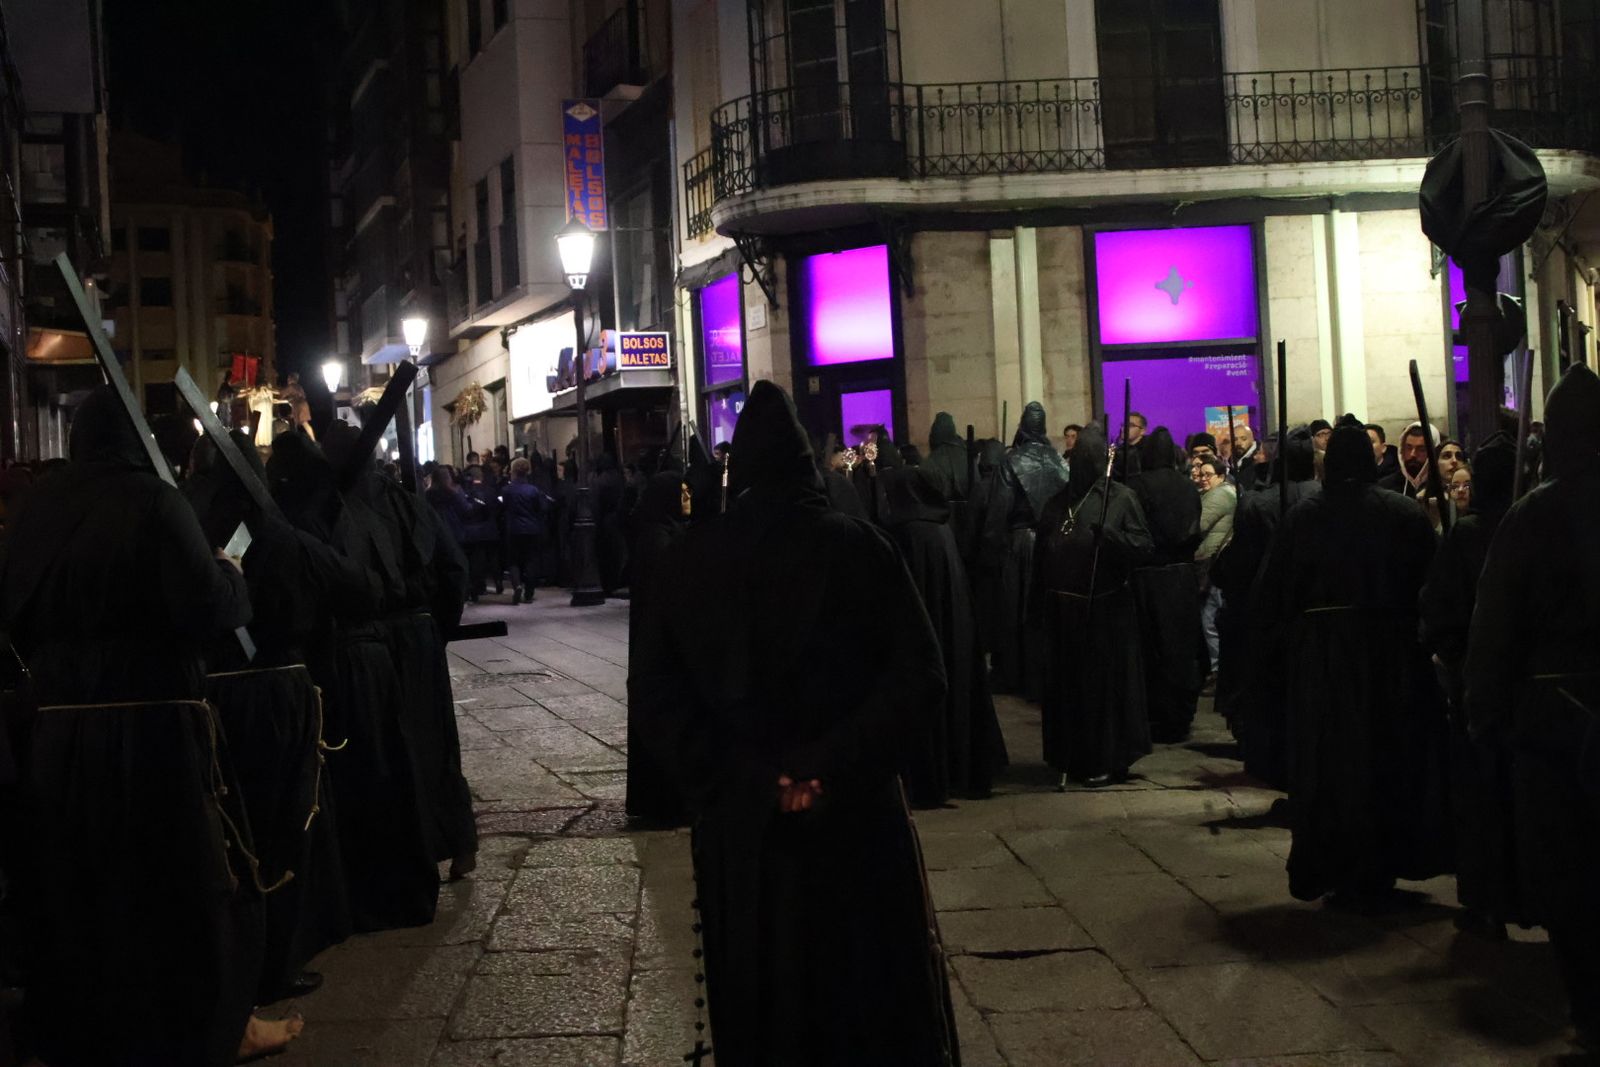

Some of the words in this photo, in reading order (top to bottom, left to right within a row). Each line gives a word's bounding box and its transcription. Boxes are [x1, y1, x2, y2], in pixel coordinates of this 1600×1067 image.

[585, 134, 604, 225] BOLSOS
[623, 338, 663, 349] BOLSOS
[621, 353, 667, 365] MALETAS
